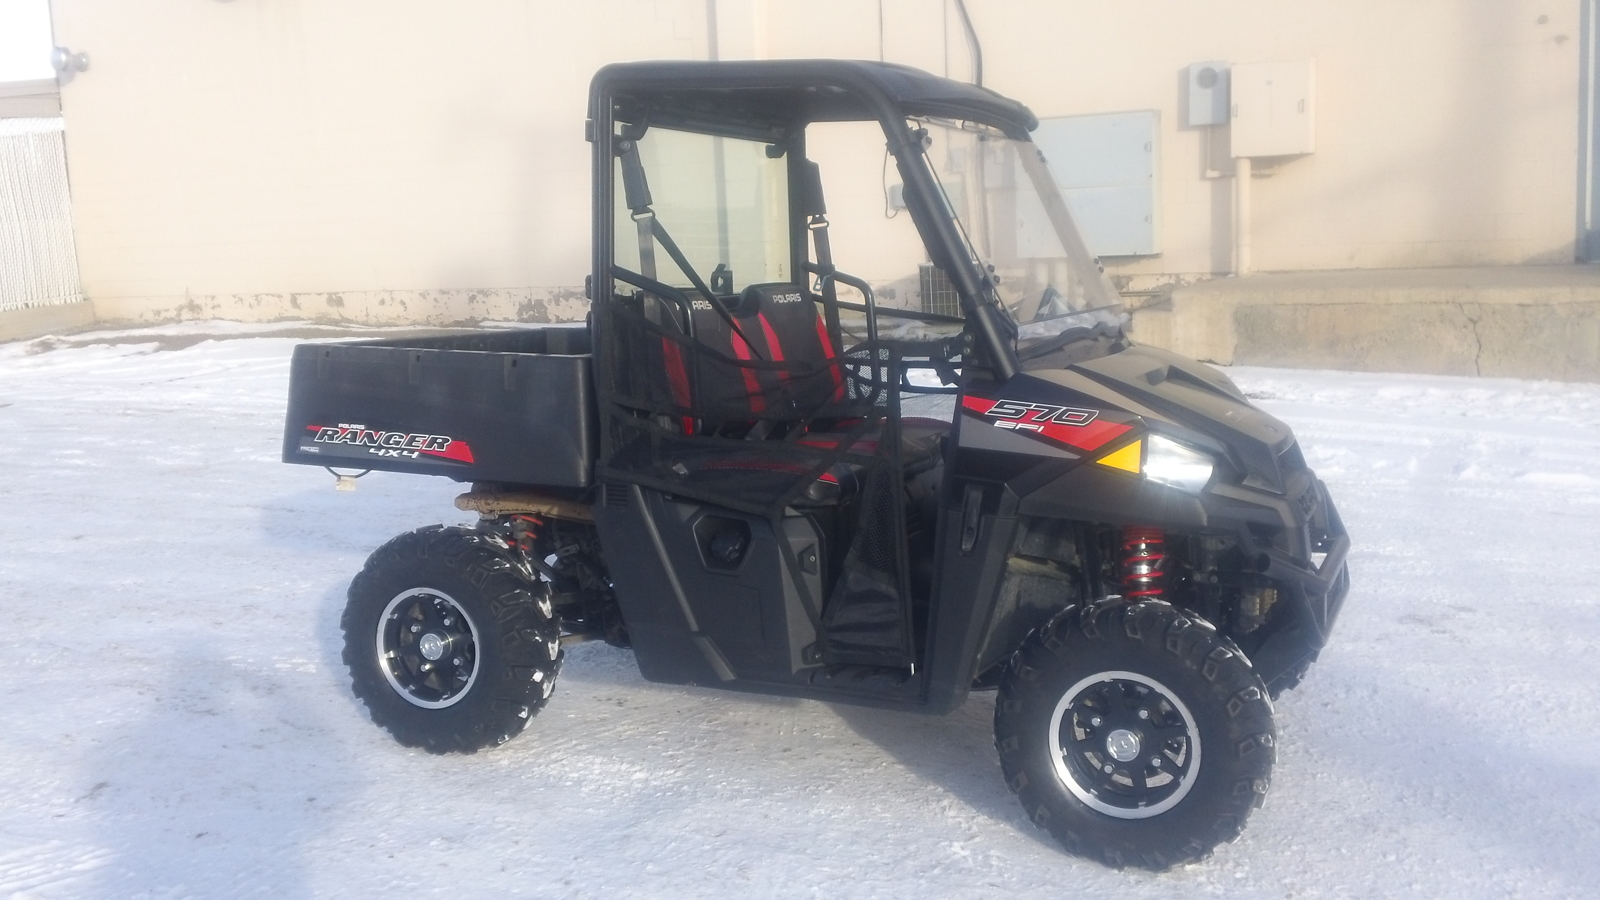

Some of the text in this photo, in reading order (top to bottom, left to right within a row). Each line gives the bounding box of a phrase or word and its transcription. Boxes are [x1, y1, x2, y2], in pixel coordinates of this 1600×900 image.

[772, 293, 802, 303] POLARIS
[985, 399, 1099, 426] 570
[314, 427, 451, 451] RANGER
